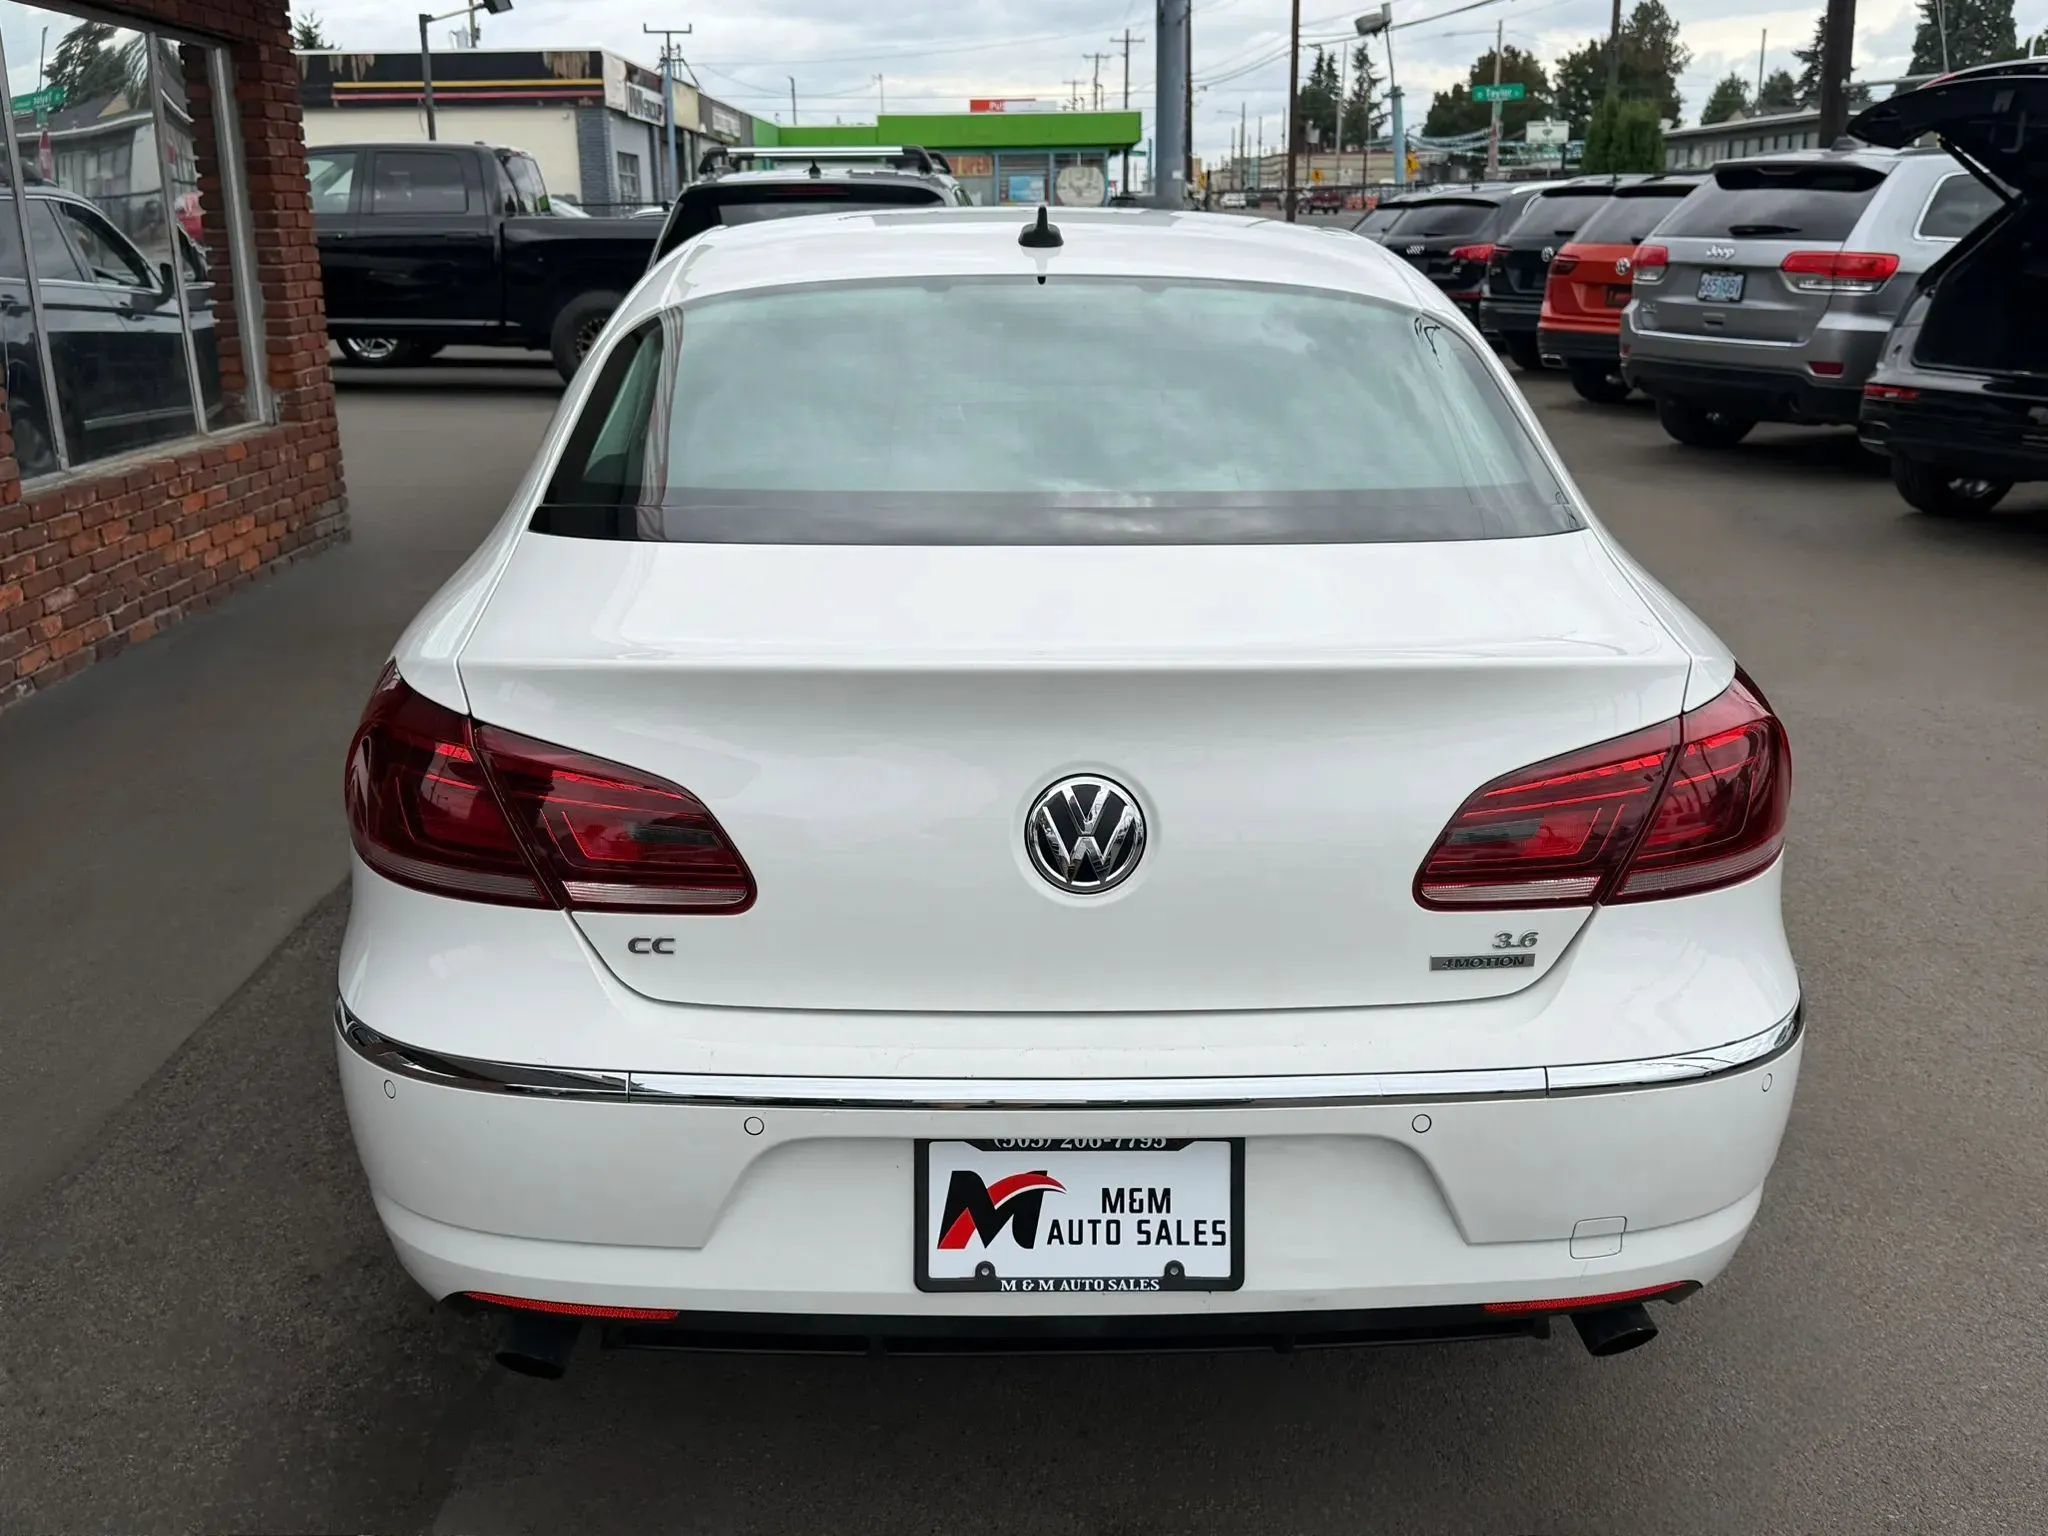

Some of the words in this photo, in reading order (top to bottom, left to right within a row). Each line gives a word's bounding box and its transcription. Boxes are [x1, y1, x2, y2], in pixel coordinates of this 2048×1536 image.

[627, 937, 676, 955] CC
[1492, 930, 1539, 949] 3.6
[1441, 956, 1526, 970] 4MOTION
[1101, 1187, 1172, 1214] M&M
[1046, 1219, 1121, 1246] AUTO
[1136, 1219, 1227, 1246] SALES
[1000, 1279, 1017, 1291] M
[1022, 1279, 1034, 1291] &
[1038, 1279, 1055, 1291] M
[1059, 1279, 1104, 1291] AUTO
[1107, 1279, 1160, 1291] SALES
